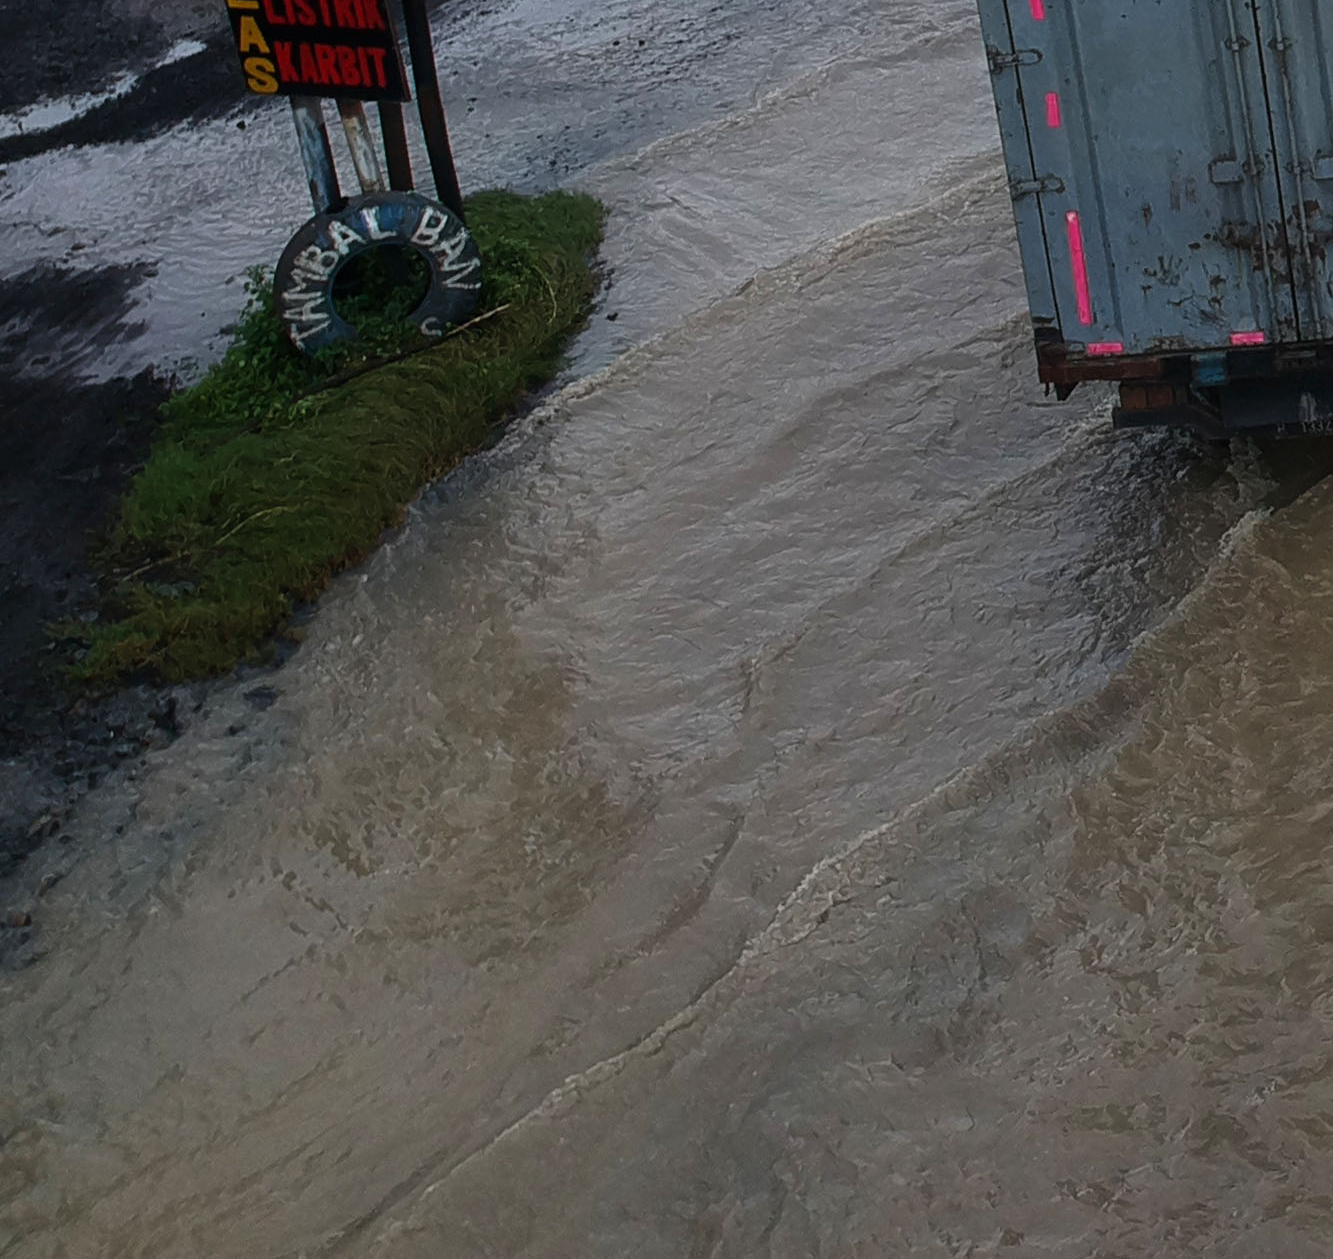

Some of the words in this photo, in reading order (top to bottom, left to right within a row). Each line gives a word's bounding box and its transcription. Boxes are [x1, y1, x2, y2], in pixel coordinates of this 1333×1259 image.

[274, 41, 387, 88] KARBIT
[282, 205, 398, 350] TAMBAL
[411, 205, 482, 290] BAN
